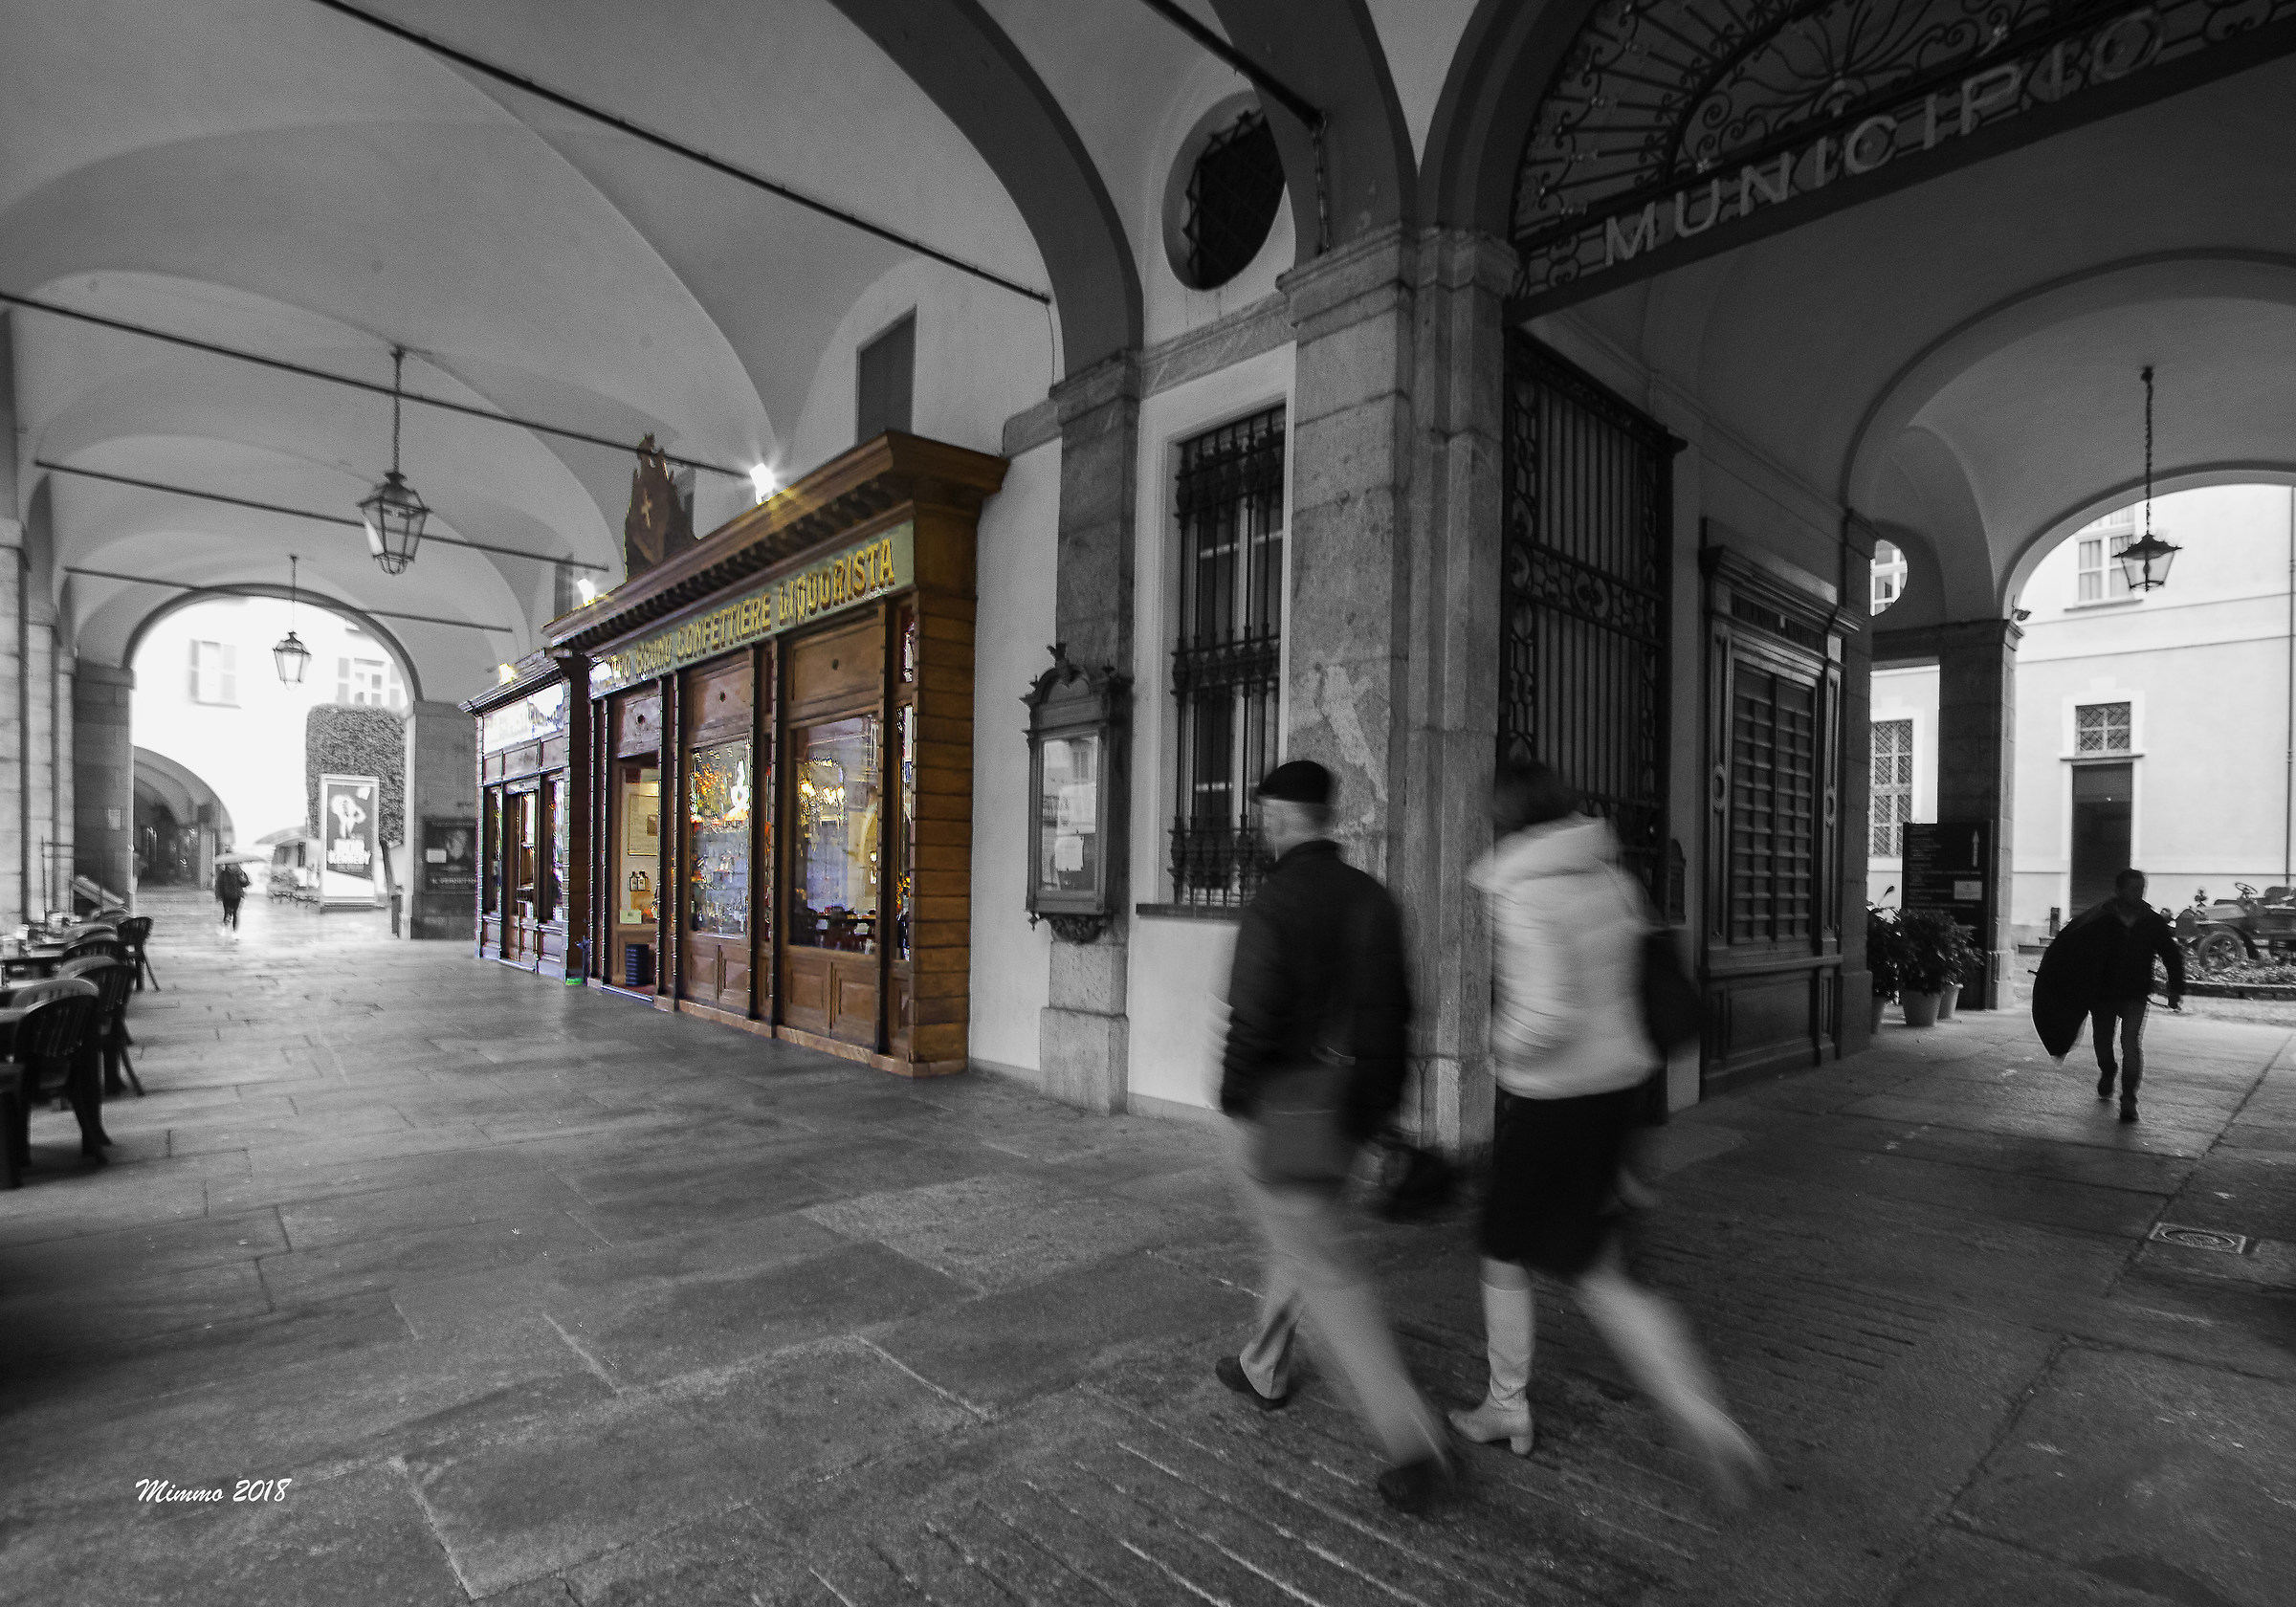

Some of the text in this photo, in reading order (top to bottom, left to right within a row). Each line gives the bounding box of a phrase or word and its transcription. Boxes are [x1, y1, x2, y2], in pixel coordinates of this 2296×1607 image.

[1604, 8, 2166, 267] MUNICIPIO
[676, 591, 772, 662] CONFETTIERE
[779, 538, 895, 626] LIQUORISTA
